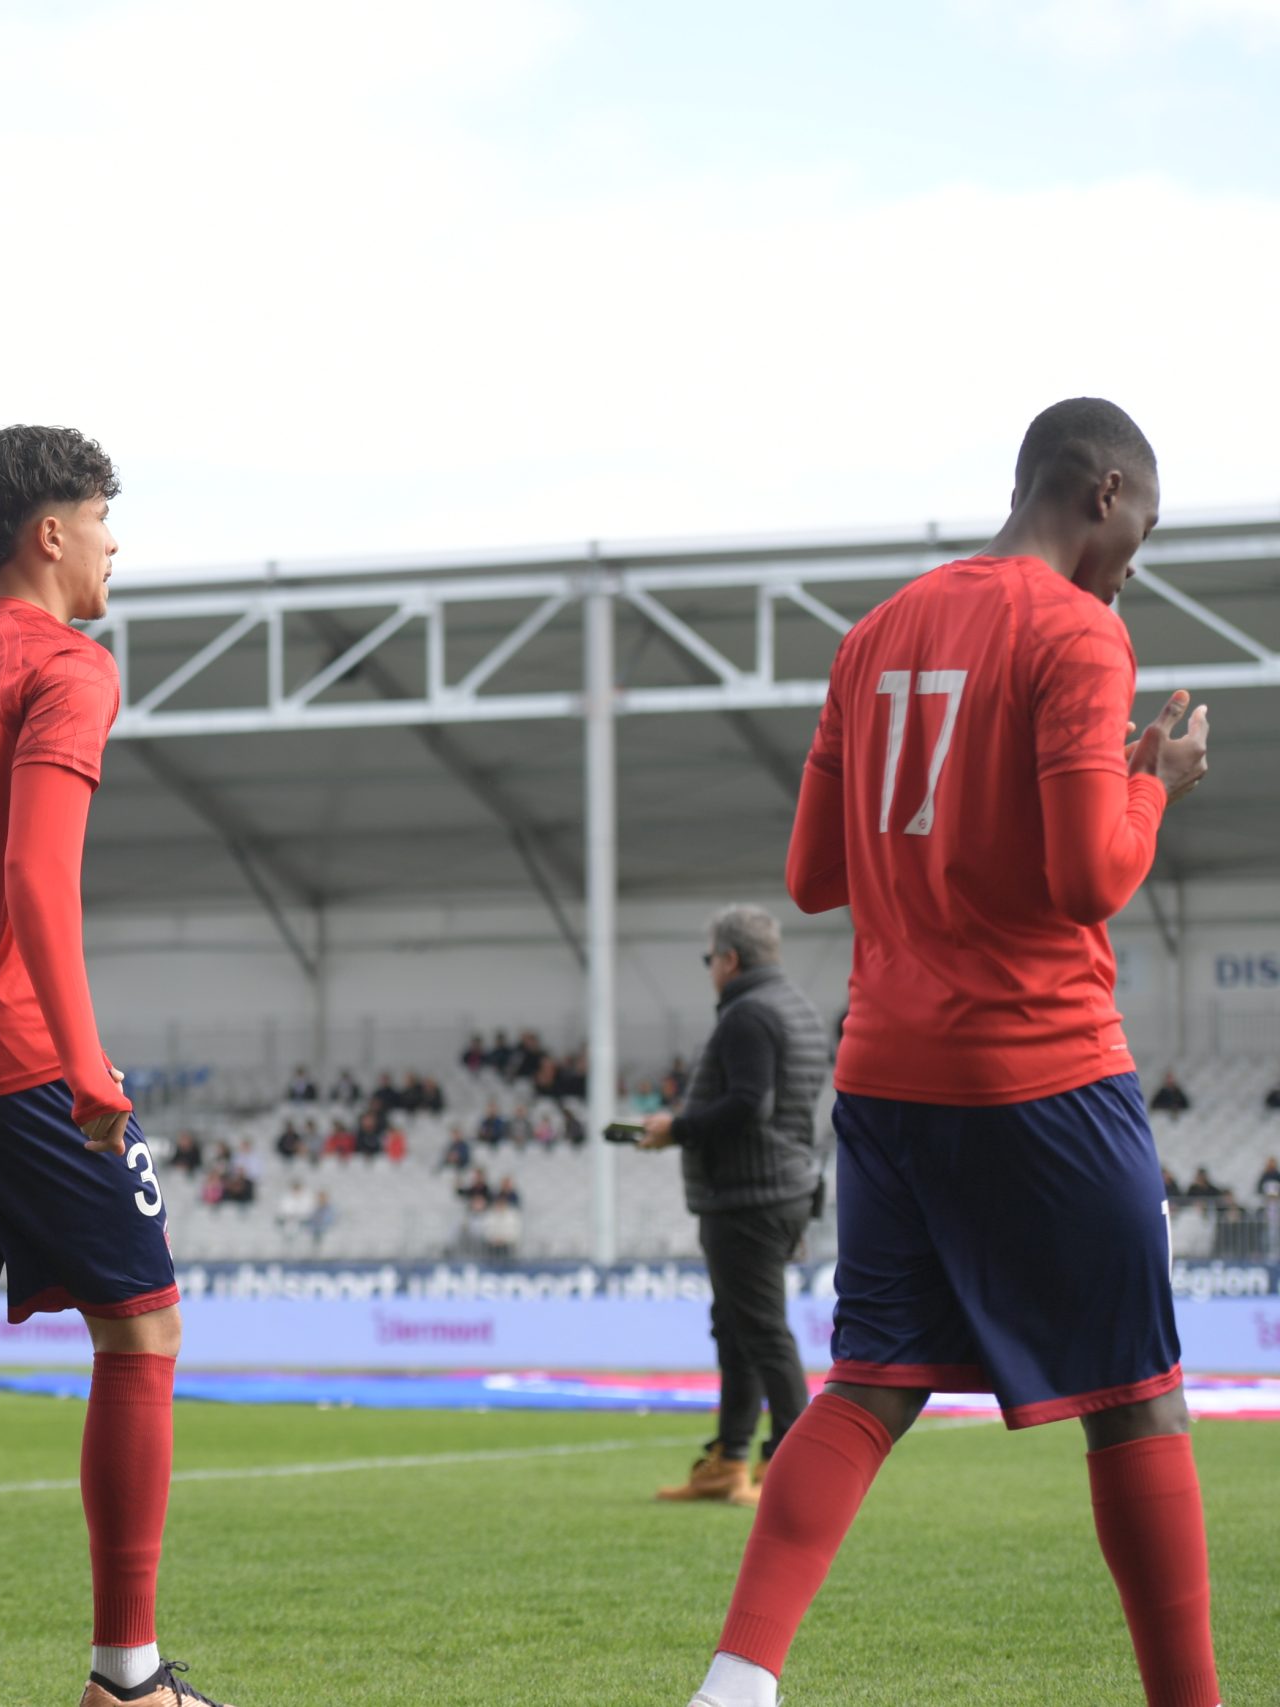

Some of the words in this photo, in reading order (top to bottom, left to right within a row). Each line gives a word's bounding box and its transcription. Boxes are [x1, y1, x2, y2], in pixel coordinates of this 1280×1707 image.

[877, 670, 968, 835] 17
[127, 1142, 162, 1217] 3
[213, 1264, 398, 1300] uhlsport
[407, 1264, 598, 1300] uhlsport
